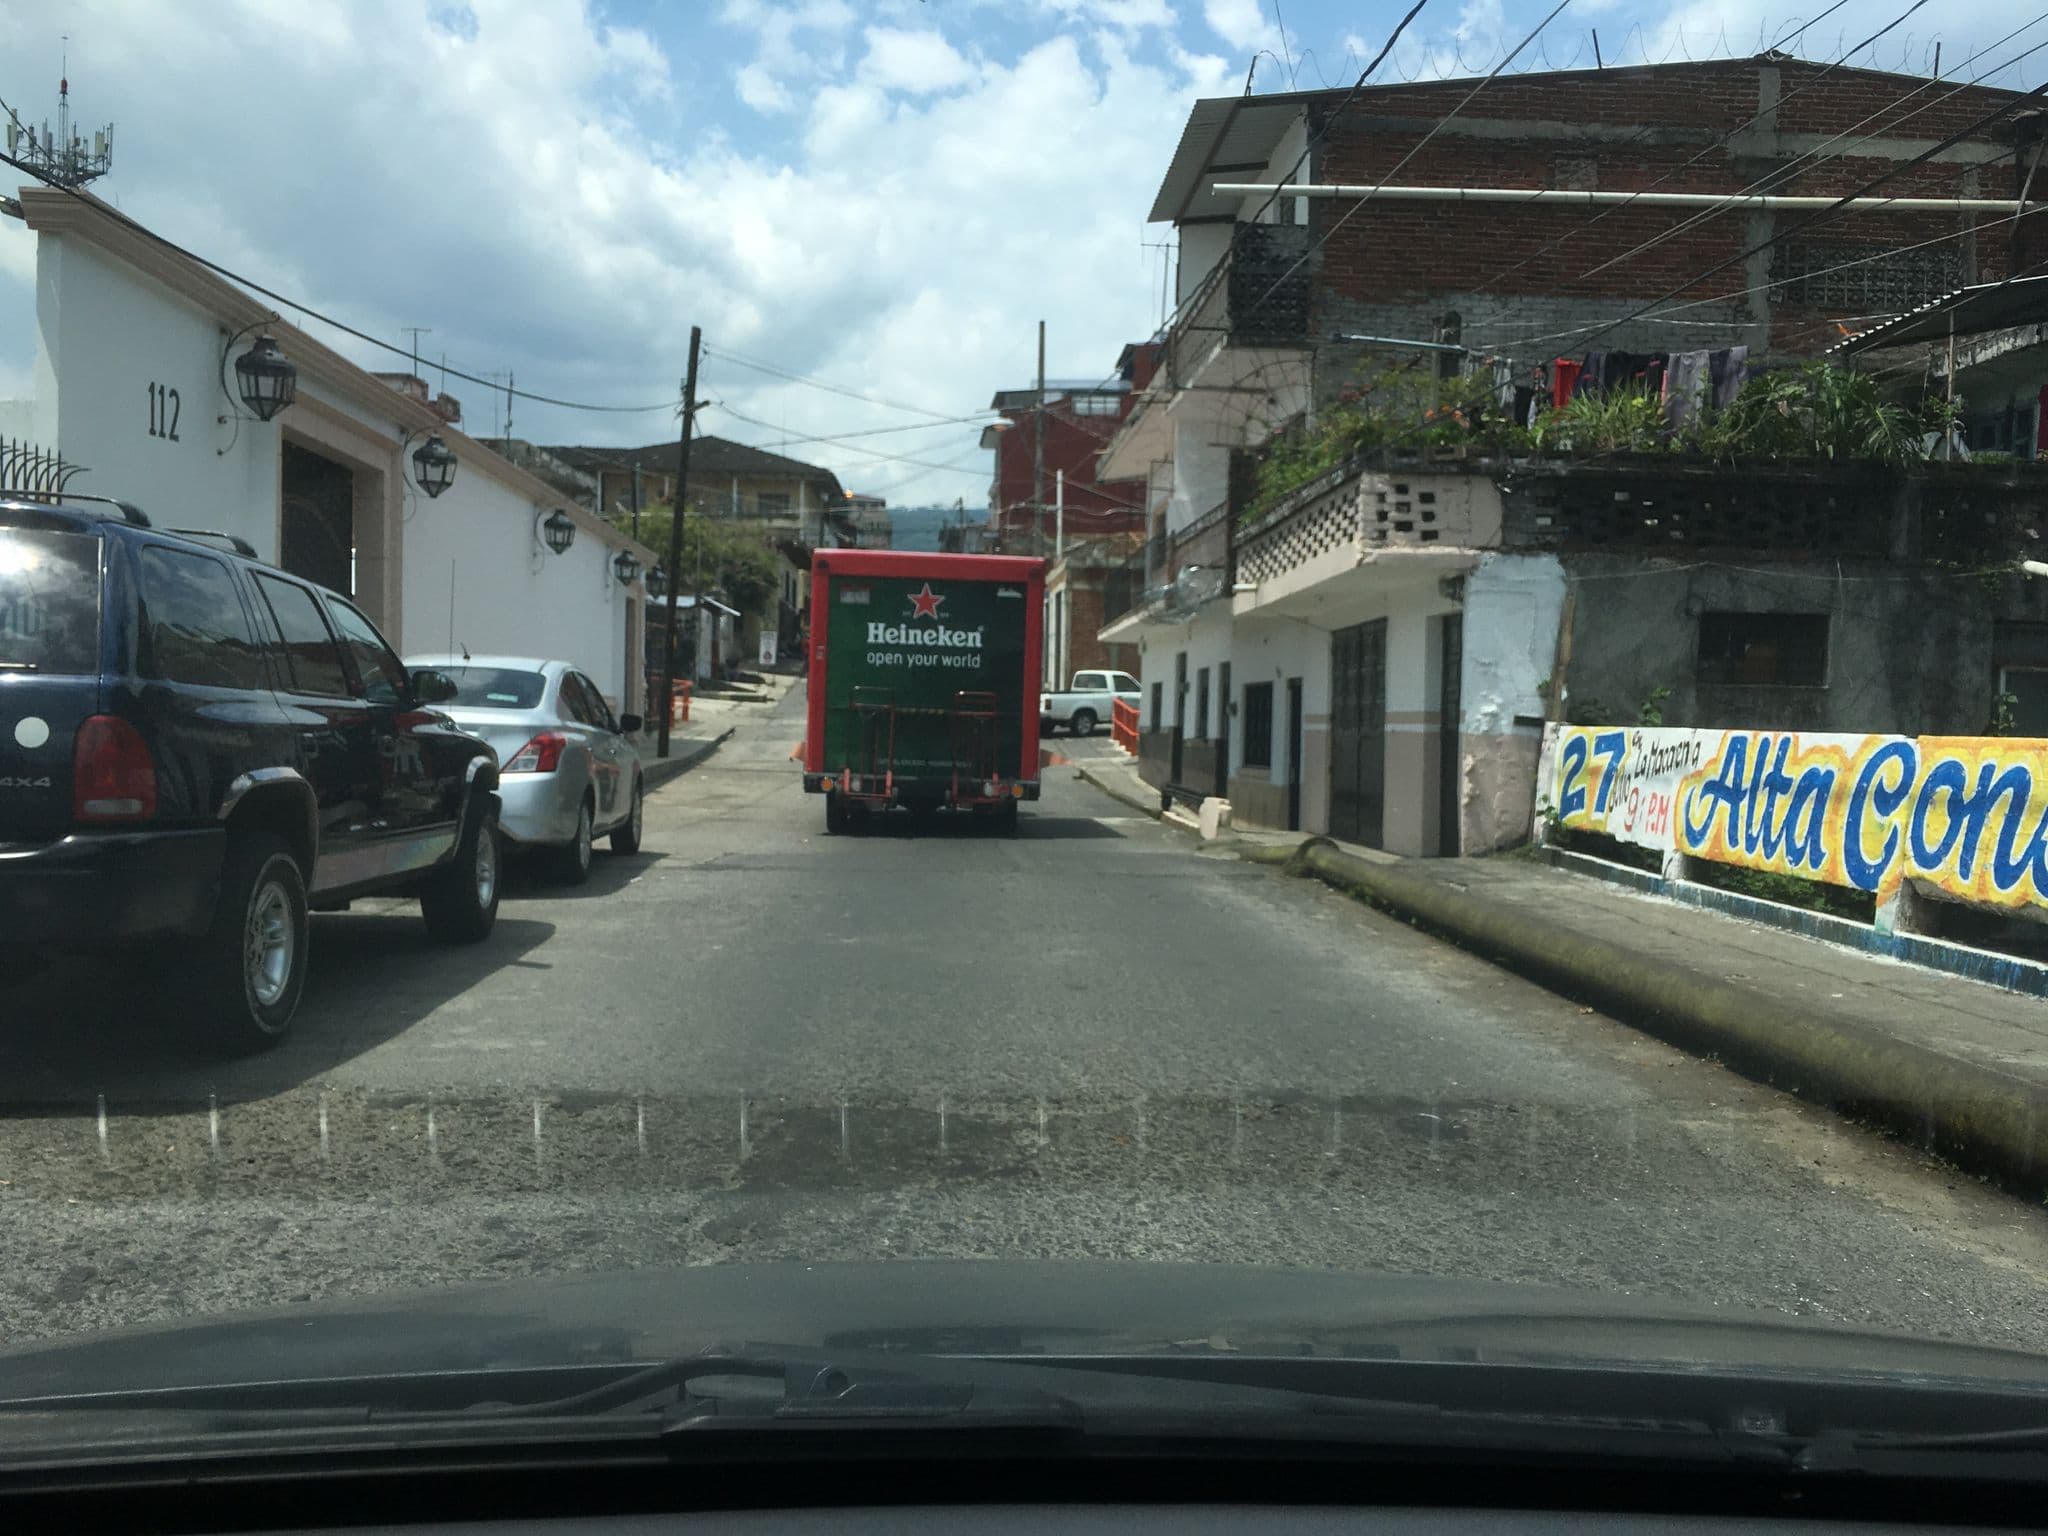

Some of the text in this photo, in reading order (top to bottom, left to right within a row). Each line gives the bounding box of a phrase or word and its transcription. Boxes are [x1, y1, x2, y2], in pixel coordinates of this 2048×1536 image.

[148, 381, 180, 442] 112
[867, 622, 982, 648] Heineken
[867, 652, 981, 668] open your world
[1559, 731, 1626, 821] 27
[1685, 735, 1835, 870] Alta
